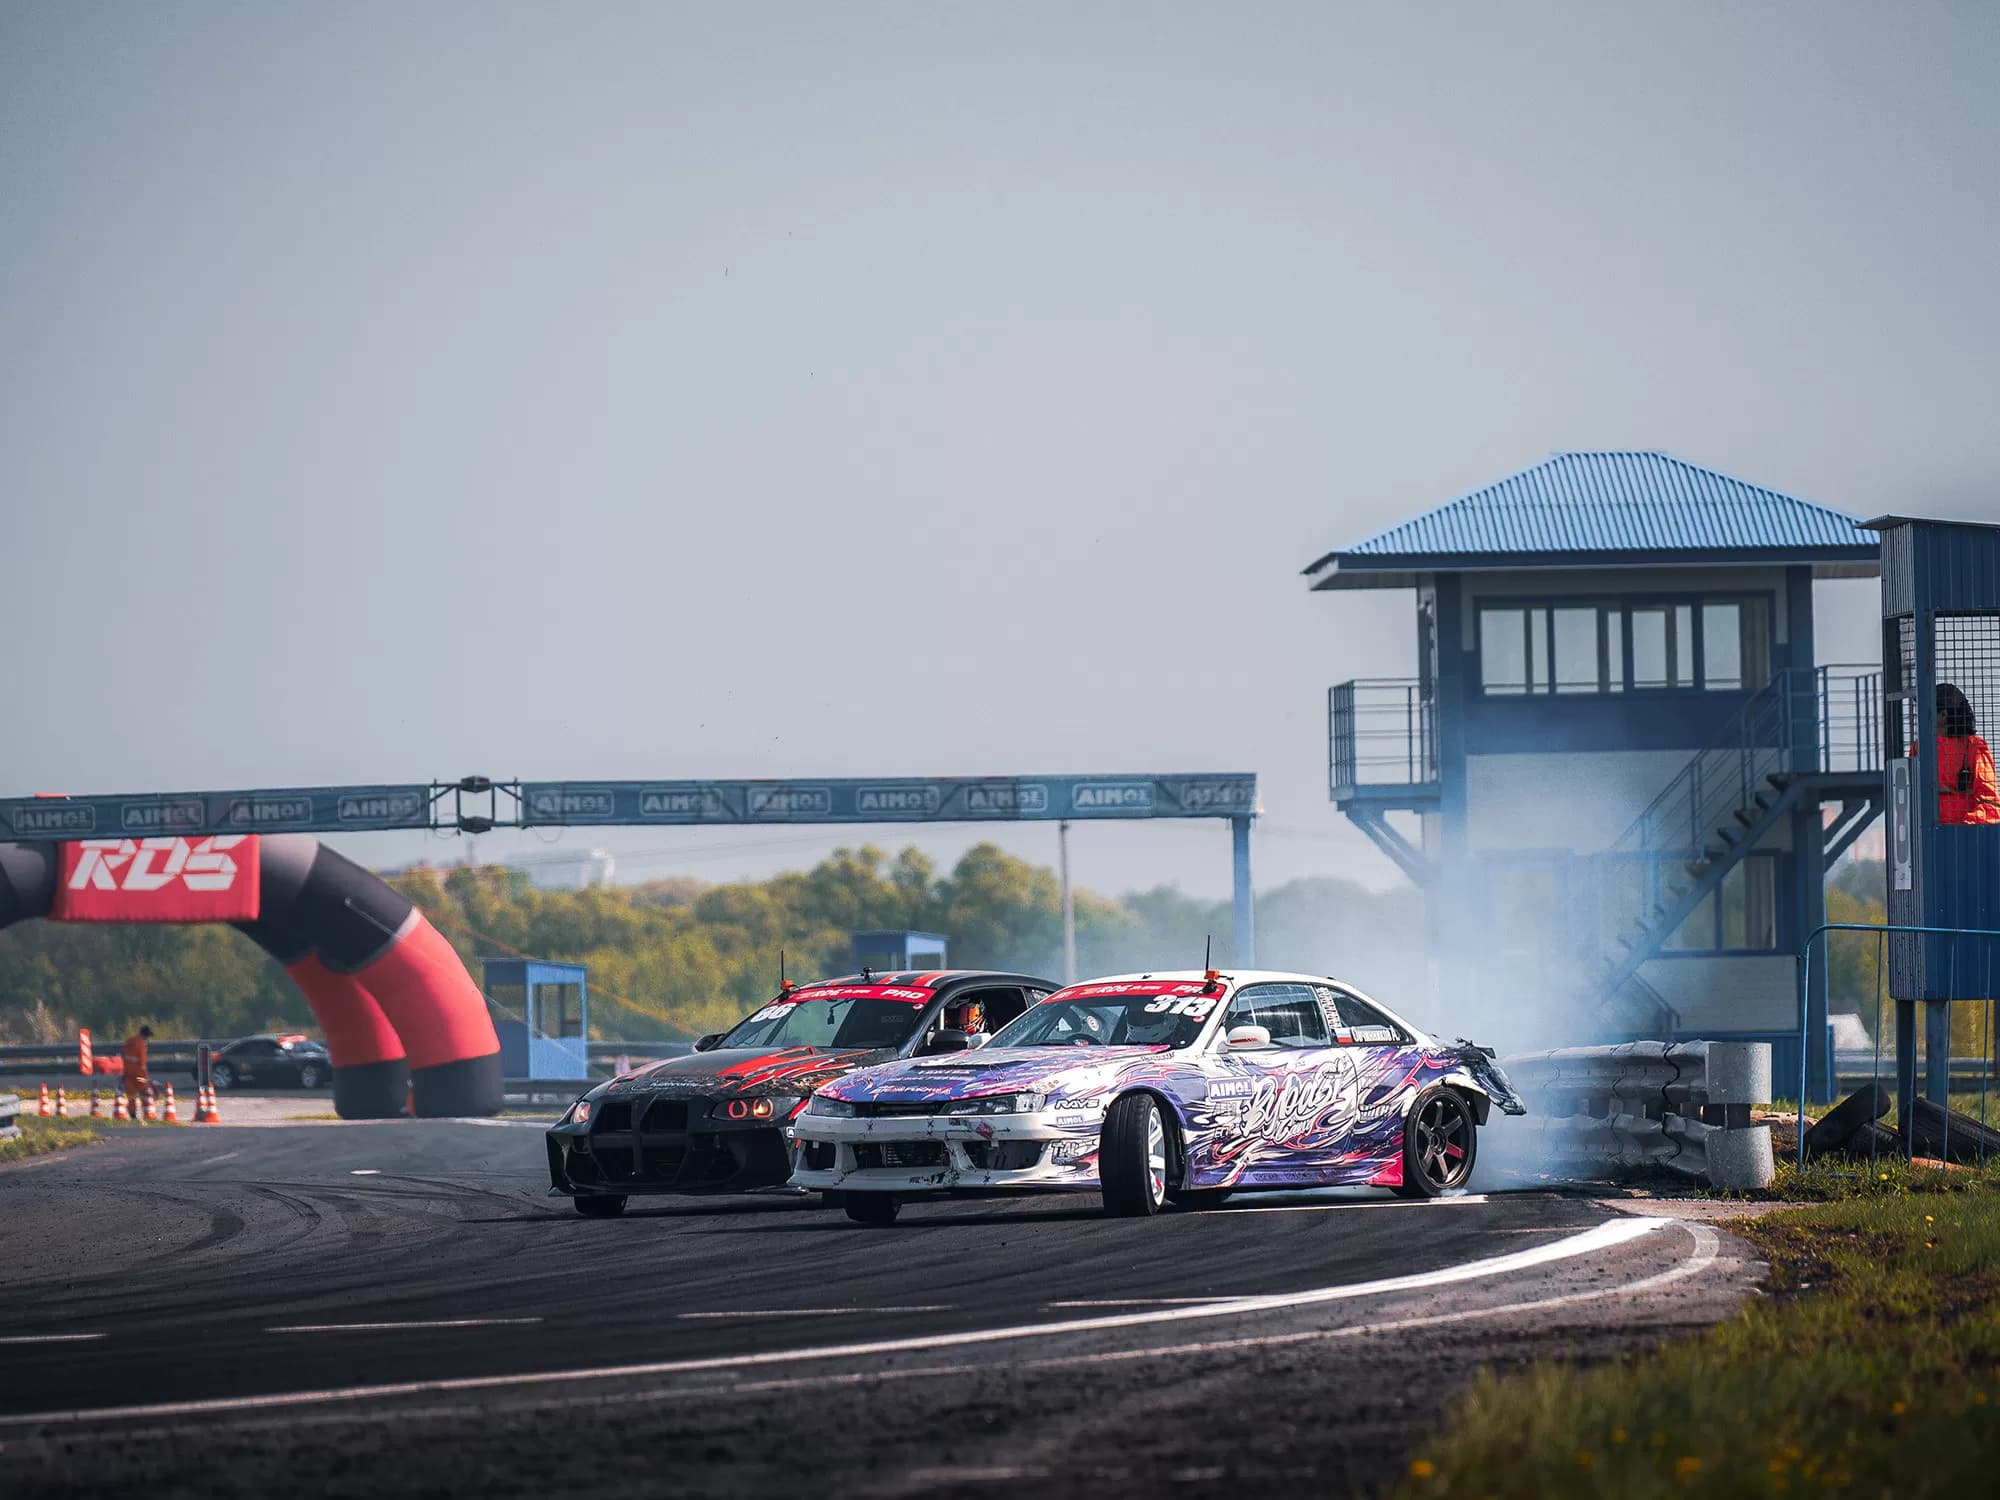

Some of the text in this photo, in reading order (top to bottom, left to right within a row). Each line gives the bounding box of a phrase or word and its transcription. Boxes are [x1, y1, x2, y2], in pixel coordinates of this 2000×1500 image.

[1076, 788, 1148, 806] AIMOL
[68, 834, 249, 892] RDS
[880, 988, 926, 1000] PRO
[1144, 994, 1217, 1017] 313
[1210, 1080, 1252, 1098] AIMOL
[1054, 1099, 1100, 1110] RAYS
[1057, 1115, 1084, 1126] AIMOL
